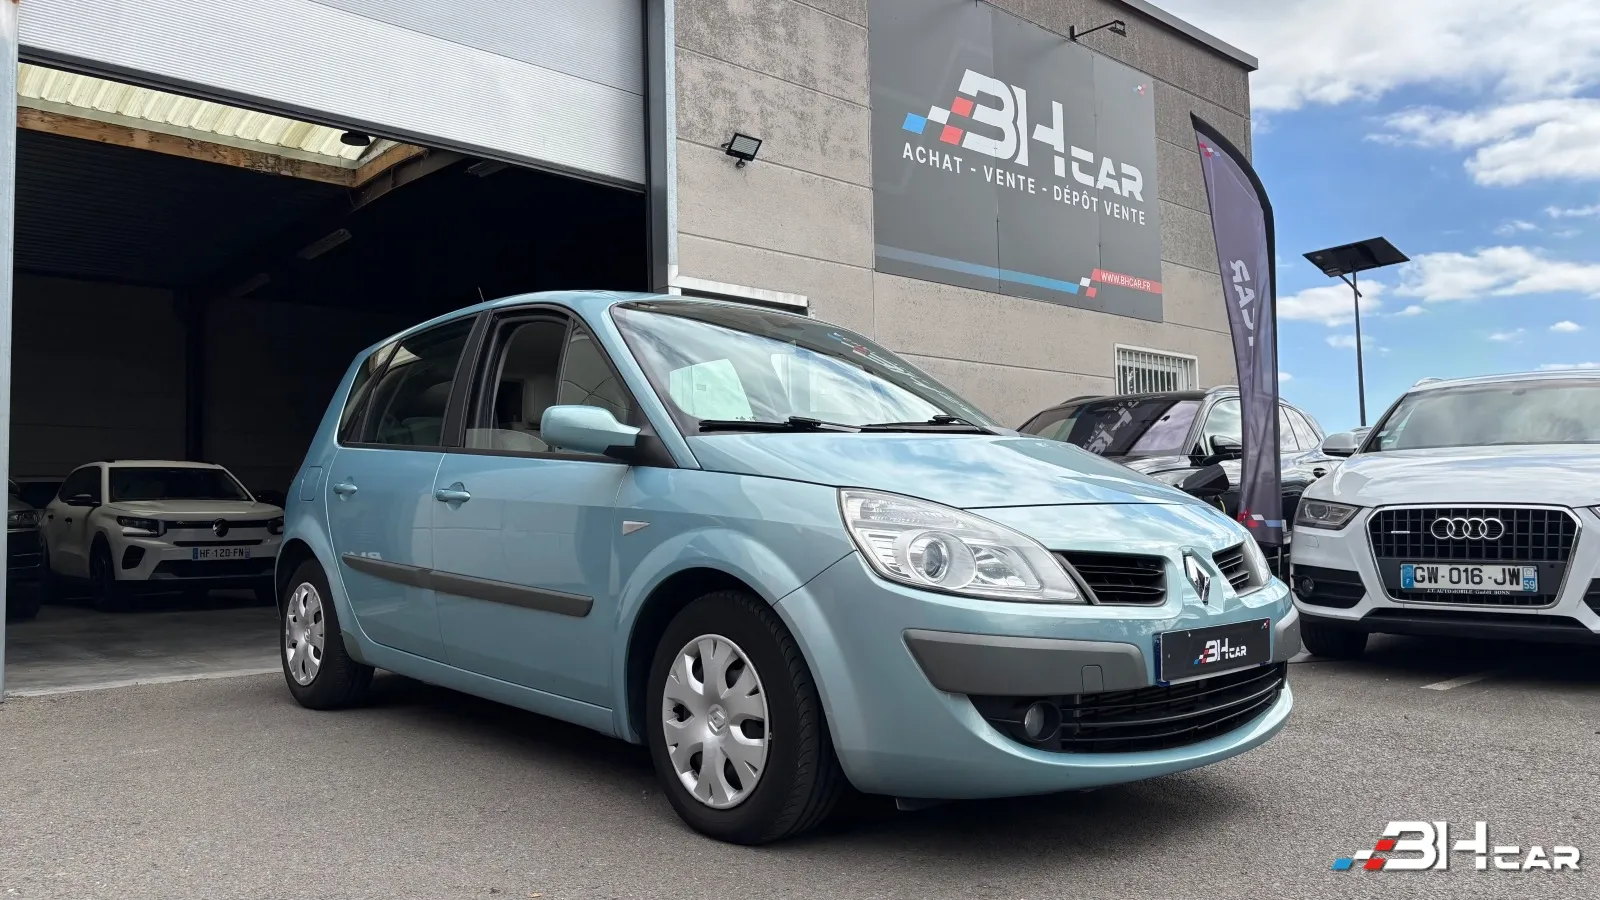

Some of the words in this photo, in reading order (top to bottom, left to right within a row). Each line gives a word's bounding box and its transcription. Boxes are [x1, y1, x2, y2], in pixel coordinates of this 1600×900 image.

[902, 142, 963, 174] ACHAT
[984, 165, 1036, 194] VENTE
[1053, 184, 1099, 212] DÉPÔT
[1103, 200, 1146, 225] VENTE
[1100, 271, 1151, 291] WWW.BHCAR.FR
[1523, 580, 1535, 590] 59
